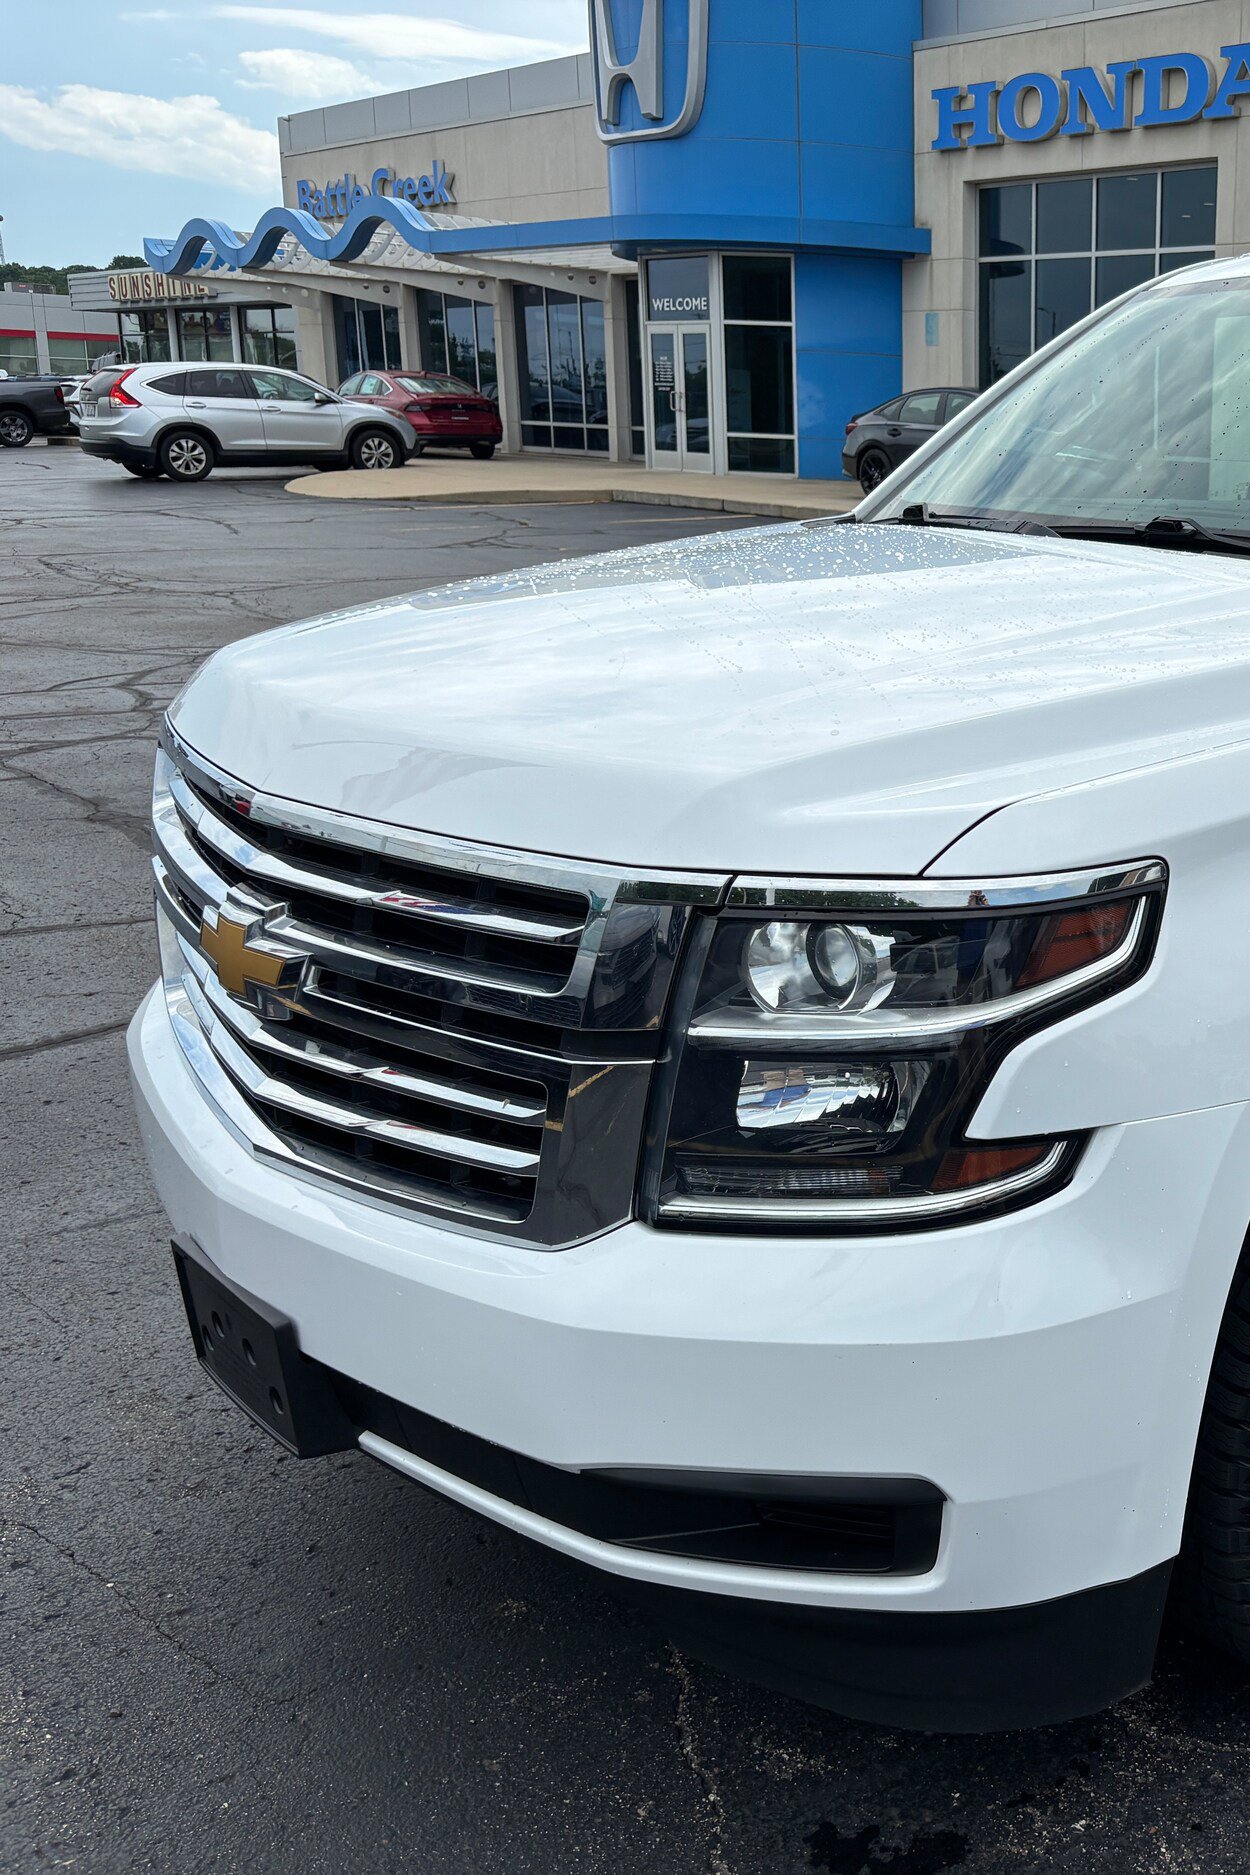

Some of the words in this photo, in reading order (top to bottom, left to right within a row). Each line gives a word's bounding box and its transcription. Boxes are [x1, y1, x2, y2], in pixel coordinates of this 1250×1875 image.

[297, 173, 366, 218] Battle
[372, 160, 457, 207] Creek
[652, 297, 708, 311] WELCOME
